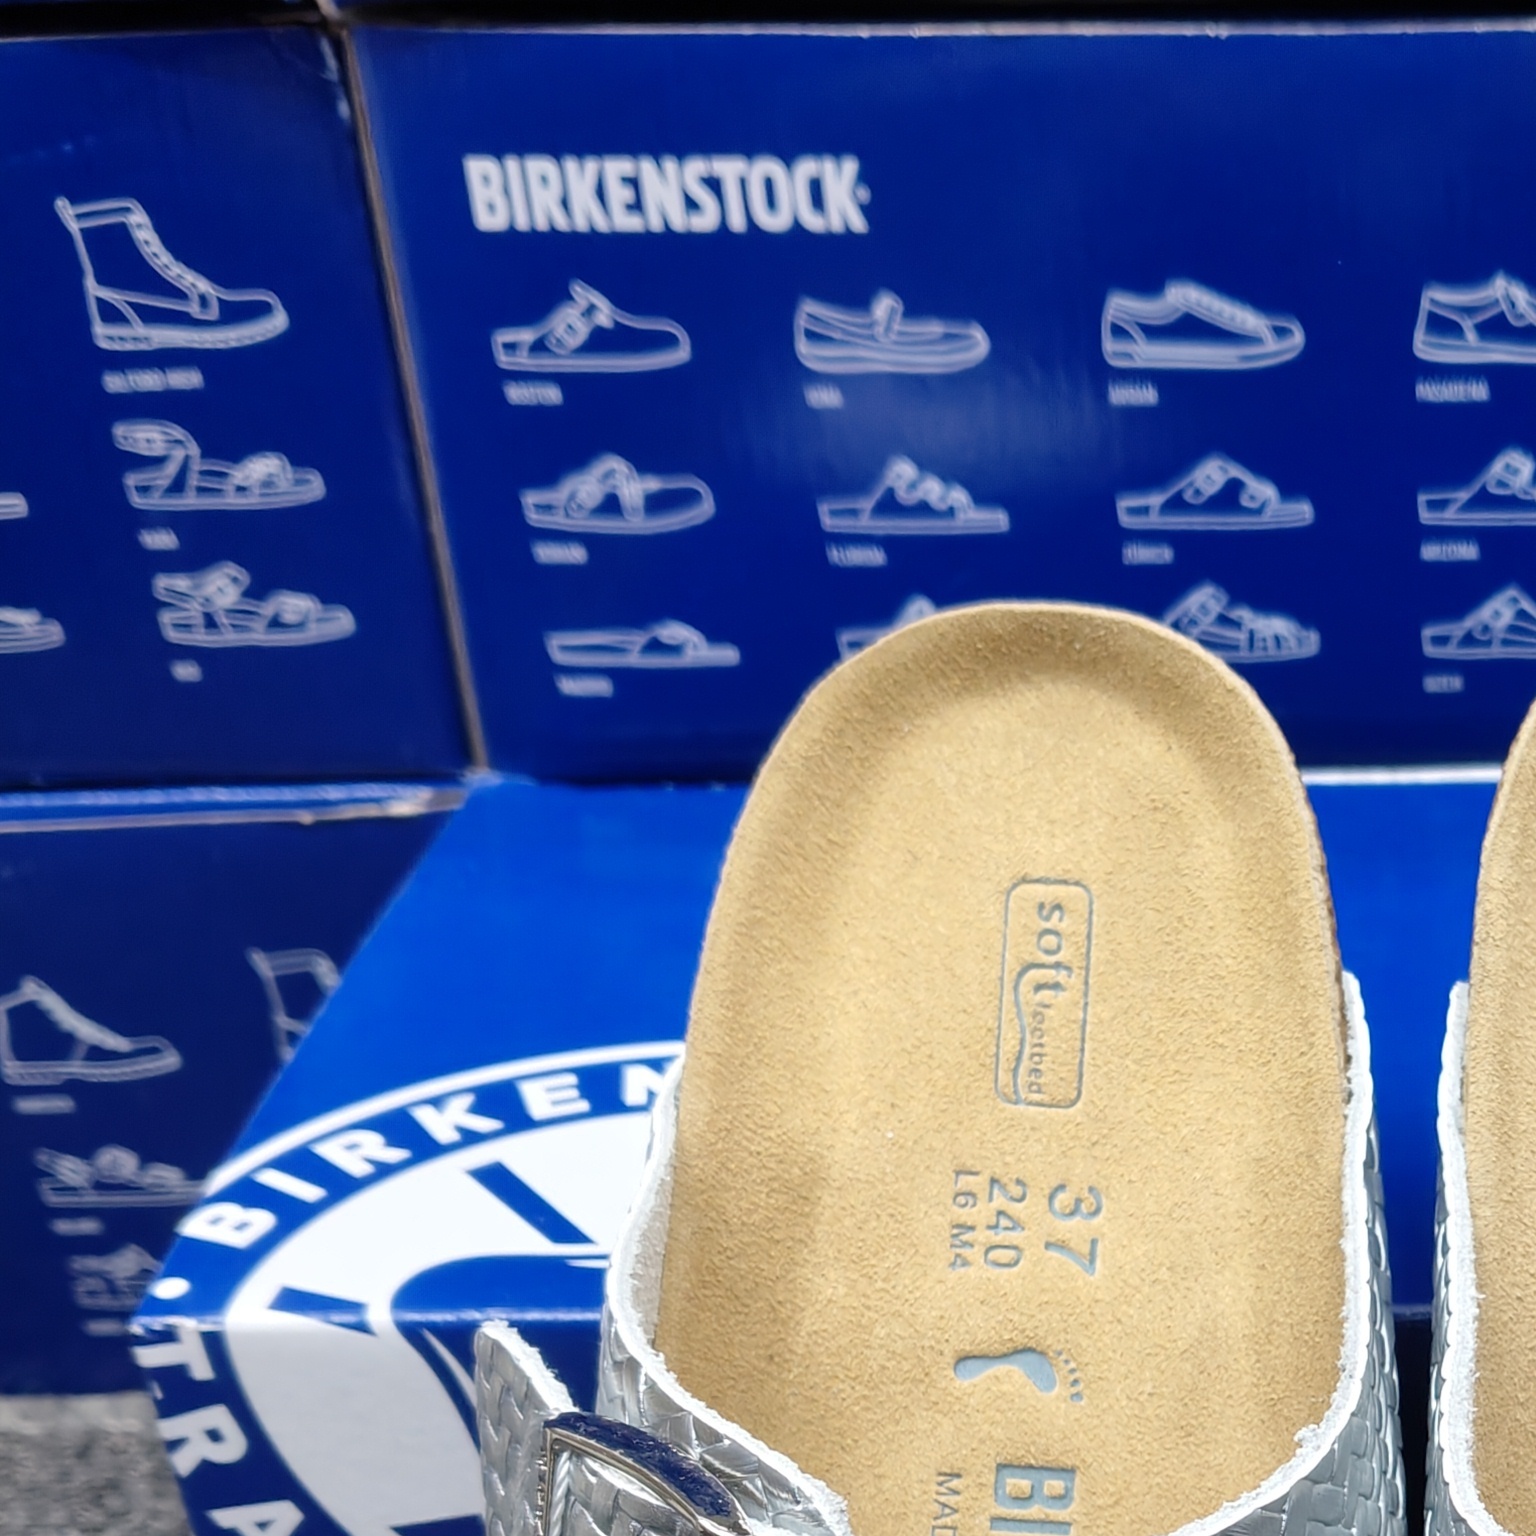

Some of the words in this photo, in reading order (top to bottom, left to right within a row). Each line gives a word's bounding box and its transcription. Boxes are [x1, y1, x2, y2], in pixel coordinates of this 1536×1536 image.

[463, 154, 870, 233] BIRKENSTOCK
[983, 1176, 1028, 1270] 240
[1044, 1183, 1104, 1277] 37
